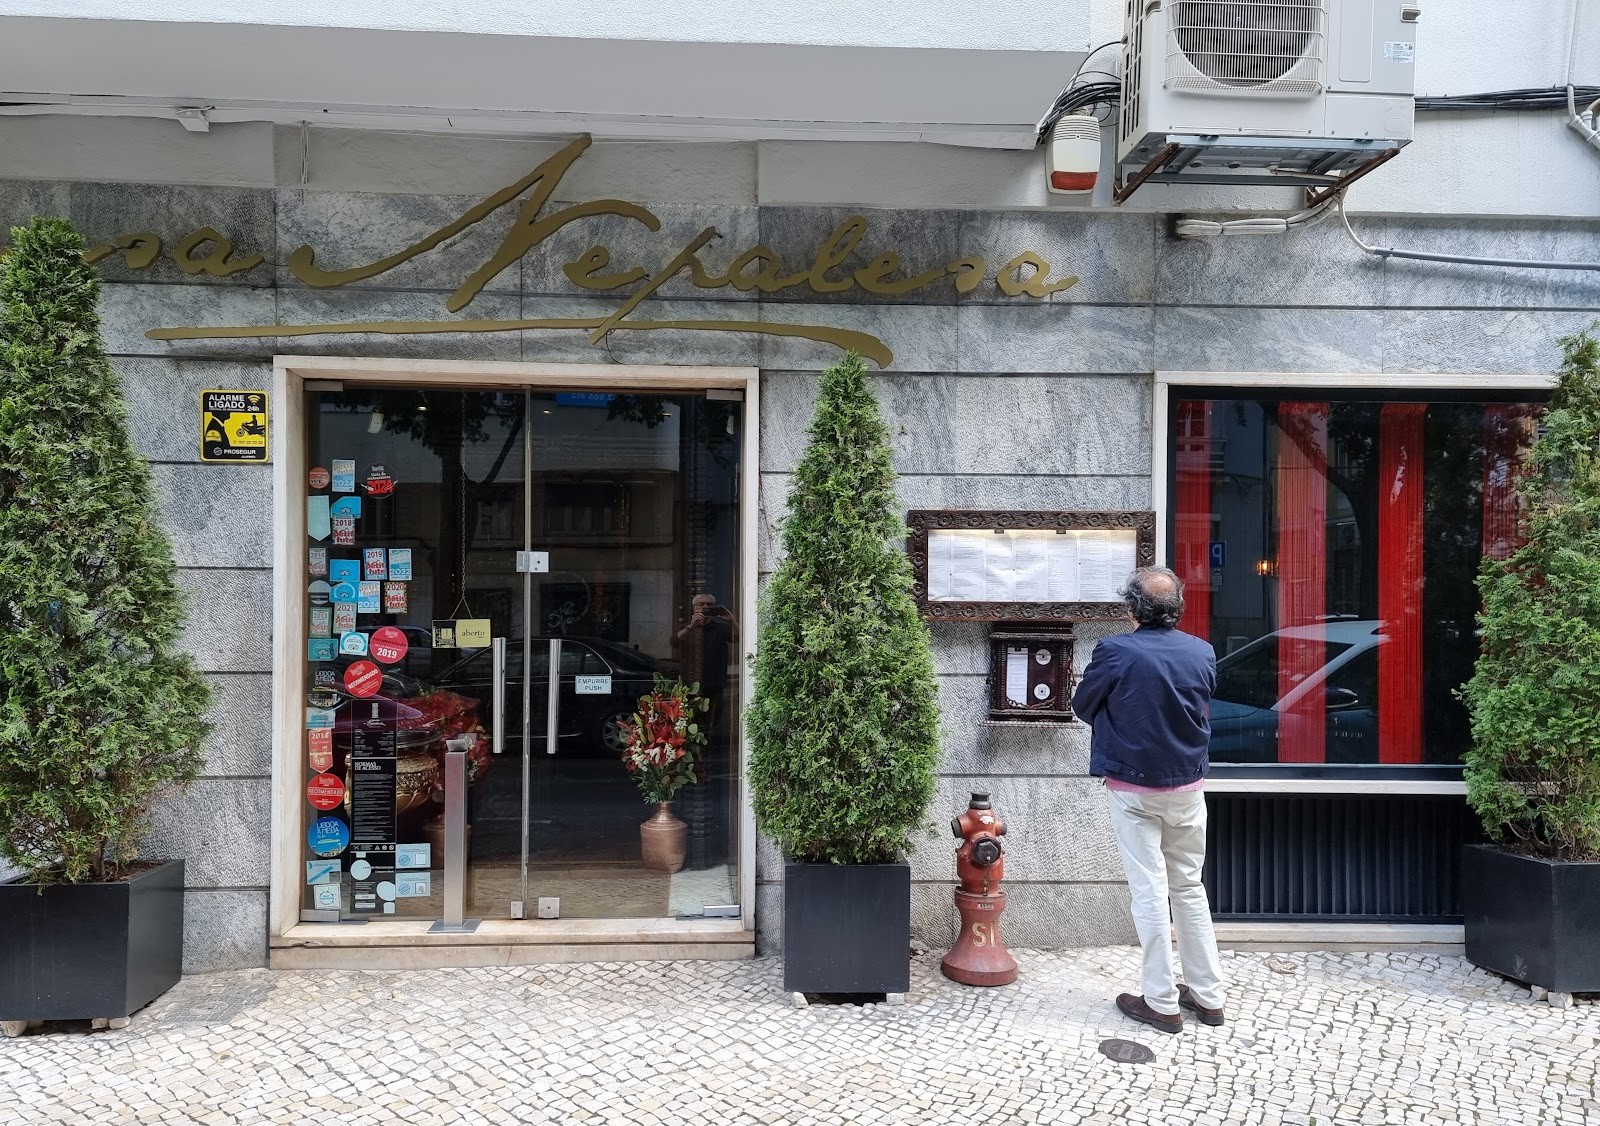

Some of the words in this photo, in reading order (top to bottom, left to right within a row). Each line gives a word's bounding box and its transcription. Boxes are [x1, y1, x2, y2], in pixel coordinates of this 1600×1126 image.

[289, 132, 1078, 344] Nepalesa
[208, 401, 246, 409] LIGADO
[366, 479, 394, 495] 2024
[335, 519, 352, 527] 2018
[366, 551, 383, 559] 2019
[387, 583, 404, 591] 2020
[337, 604, 354, 612] 2021
[461, 629, 485, 637] aberto
[377, 647, 397, 659] 2019
